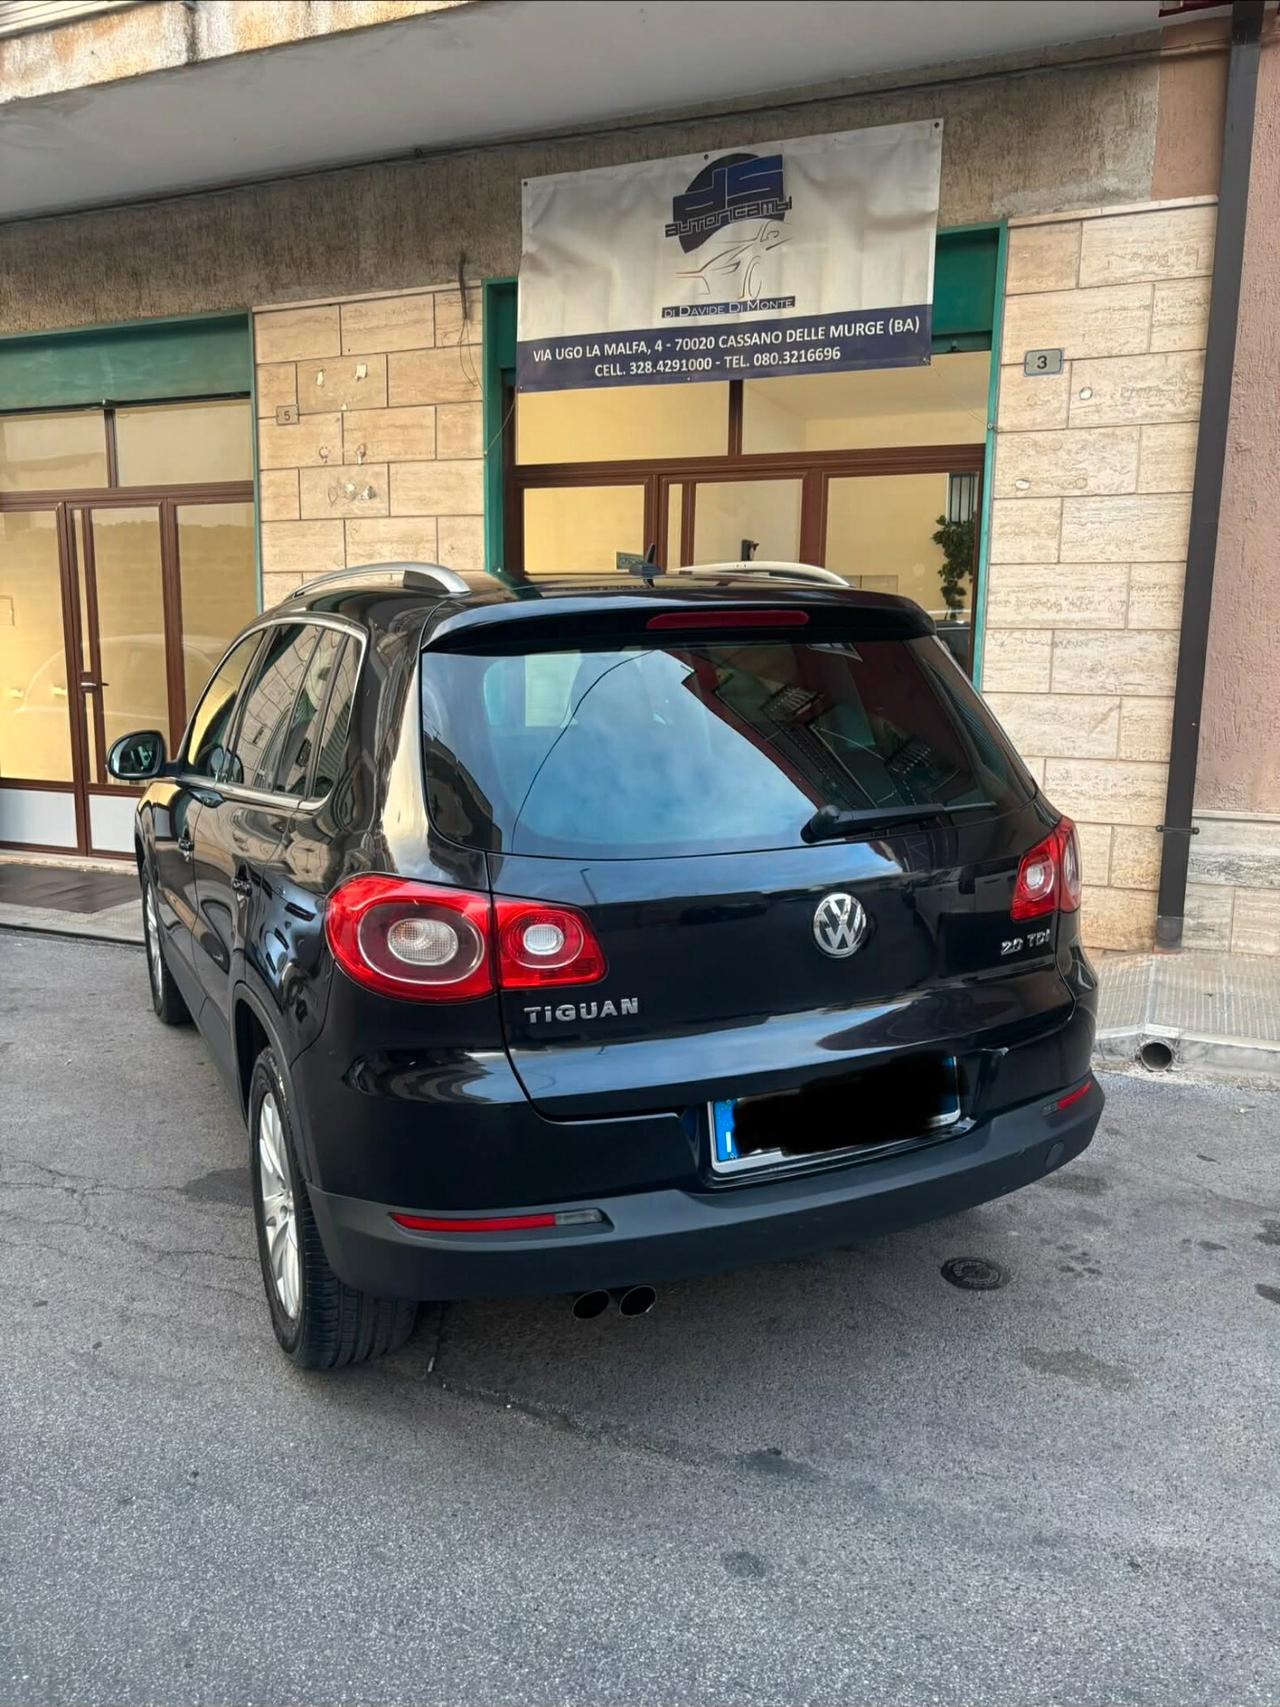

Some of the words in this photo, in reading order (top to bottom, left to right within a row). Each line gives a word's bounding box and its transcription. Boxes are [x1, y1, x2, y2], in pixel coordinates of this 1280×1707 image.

[679, 304, 725, 317] DAVIDE
[746, 299, 793, 311] MONTE
[533, 350, 553, 363] VIA
[555, 345, 583, 361] UGO
[586, 344, 601, 358] LA
[604, 340, 651, 356] MALFA,
[654, 339, 663, 353] 4
[675, 336, 715, 352] 70020
[718, 331, 783, 349] CASSANO
[786, 326, 826, 343] DELLE
[829, 320, 885, 338] MURGE
[888, 316, 920, 336] (BA)
[594, 363, 626, 377] CELL.
[629, 357, 713, 375] 328.4291000
[724, 355, 751, 369] TEL.
[753, 346, 841, 367] 080.3216696
[1036, 355, 1048, 370] 3
